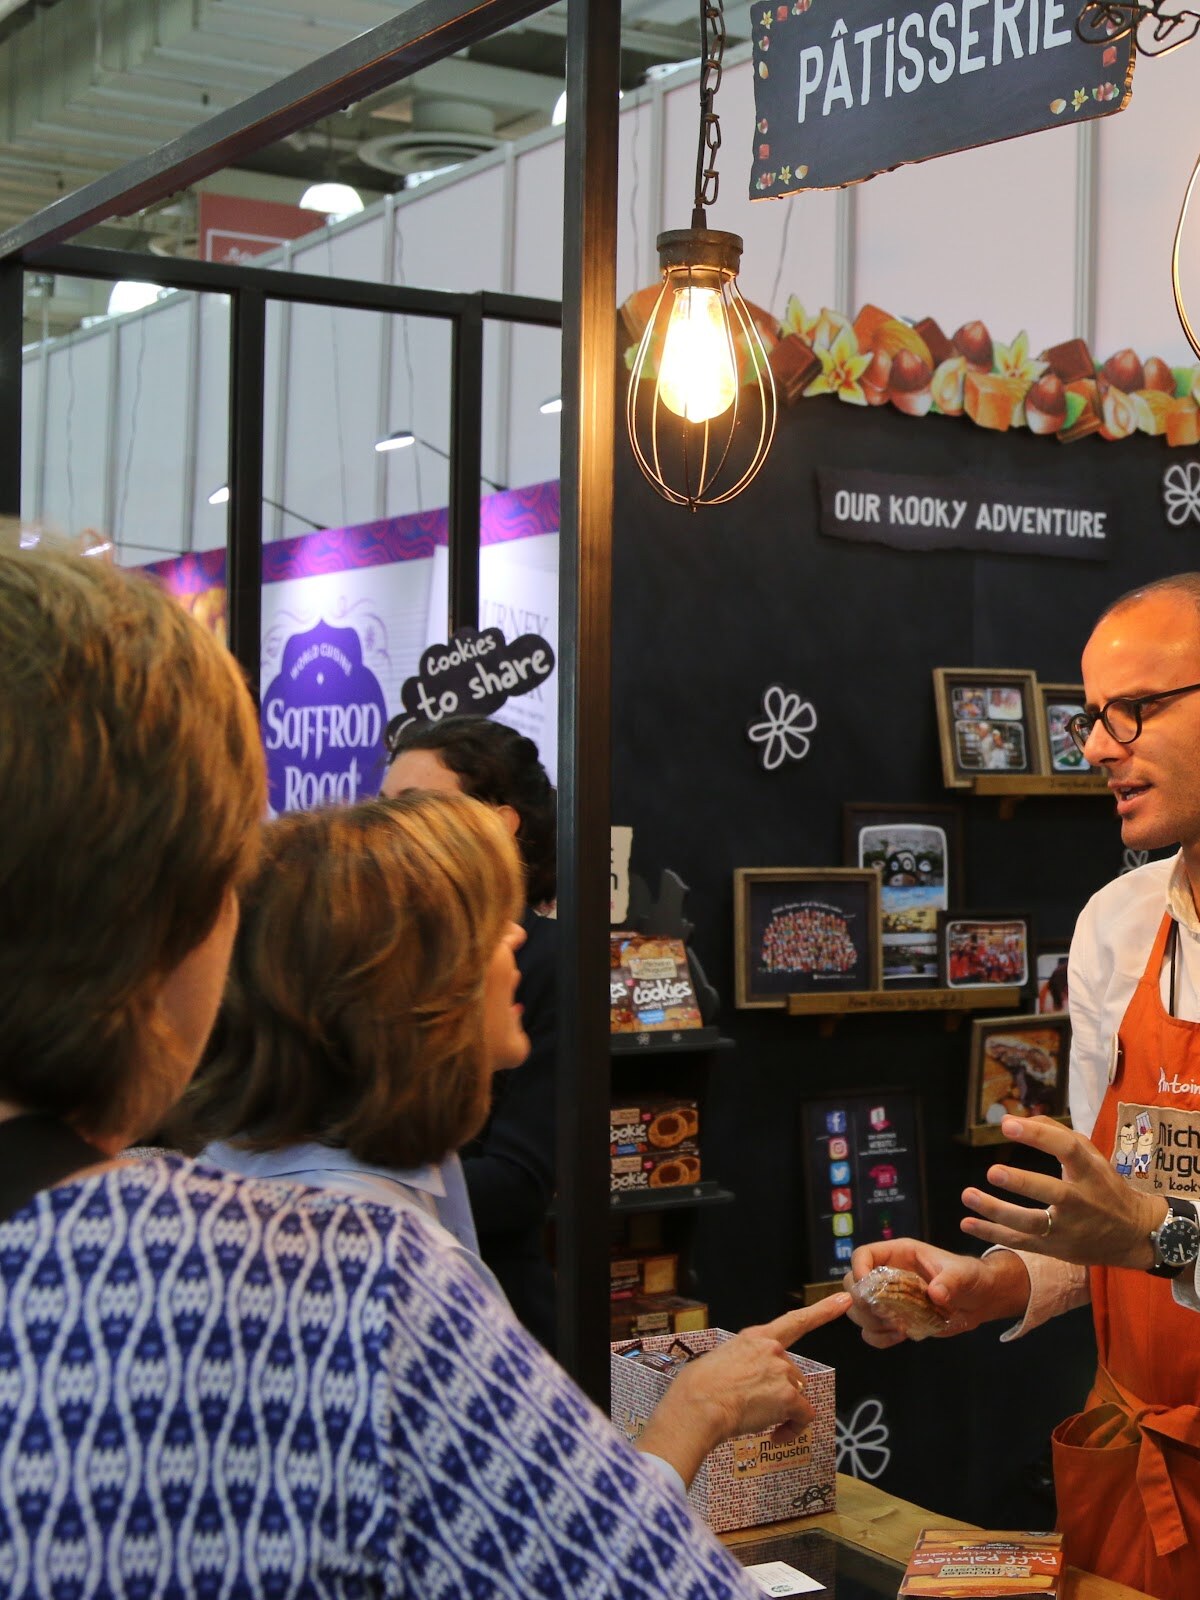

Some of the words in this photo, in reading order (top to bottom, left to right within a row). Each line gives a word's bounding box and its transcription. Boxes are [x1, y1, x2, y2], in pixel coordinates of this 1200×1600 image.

[834, 490, 880, 523] OUR
[889, 495, 968, 529] KOOKY
[975, 503, 1107, 539] ADVENTURE
[426, 634, 497, 677] cookies
[416, 682, 459, 722] to
[468, 648, 551, 700] share
[798, 1434, 809, 1444] et
[760, 1445, 811, 1463] Augustin
[913, 1554, 1000, 1566] palmiers
[1004, 1554, 1057, 1565] Puff
